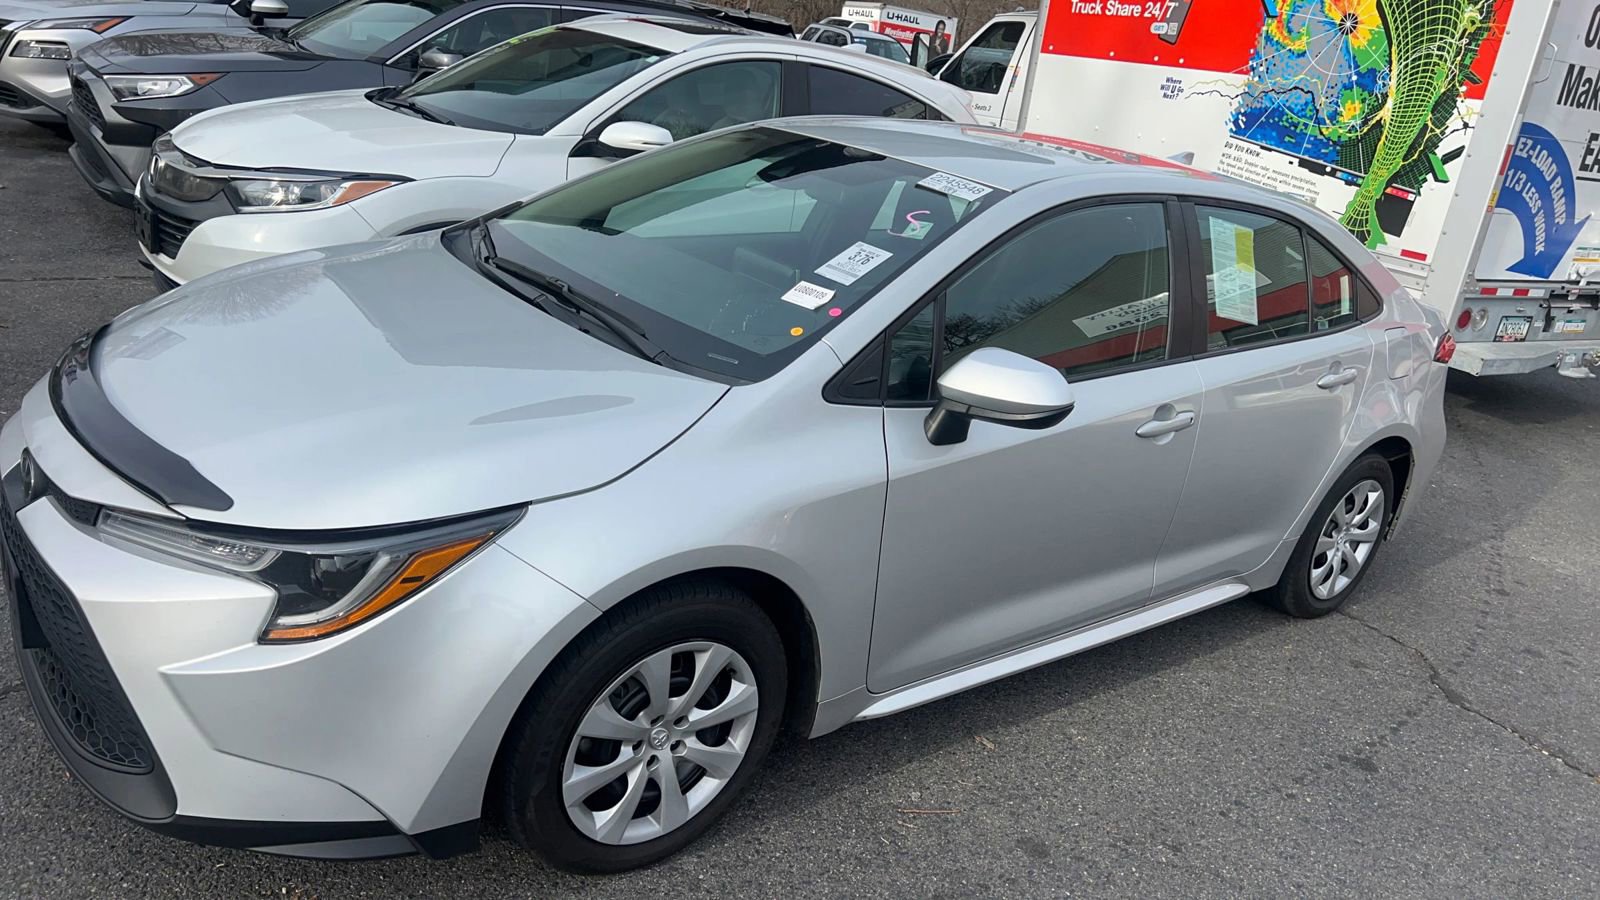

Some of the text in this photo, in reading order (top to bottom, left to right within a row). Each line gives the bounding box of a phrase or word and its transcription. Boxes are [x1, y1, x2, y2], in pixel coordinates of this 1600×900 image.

[1071, 0, 1103, 14] Truck
[1105, 0, 1141, 16] Share
[887, 11, 920, 25] U-HAUL
[1165, 76, 1182, 84] Where
[1171, 85, 1177, 94] U
[1162, 92, 1179, 100] Next?
[974, 103, 988, 111] Seats
[1514, 137, 1566, 225] EZ-LOAD RAMP
[1505, 168, 1545, 256] 1/3 LESS WORK
